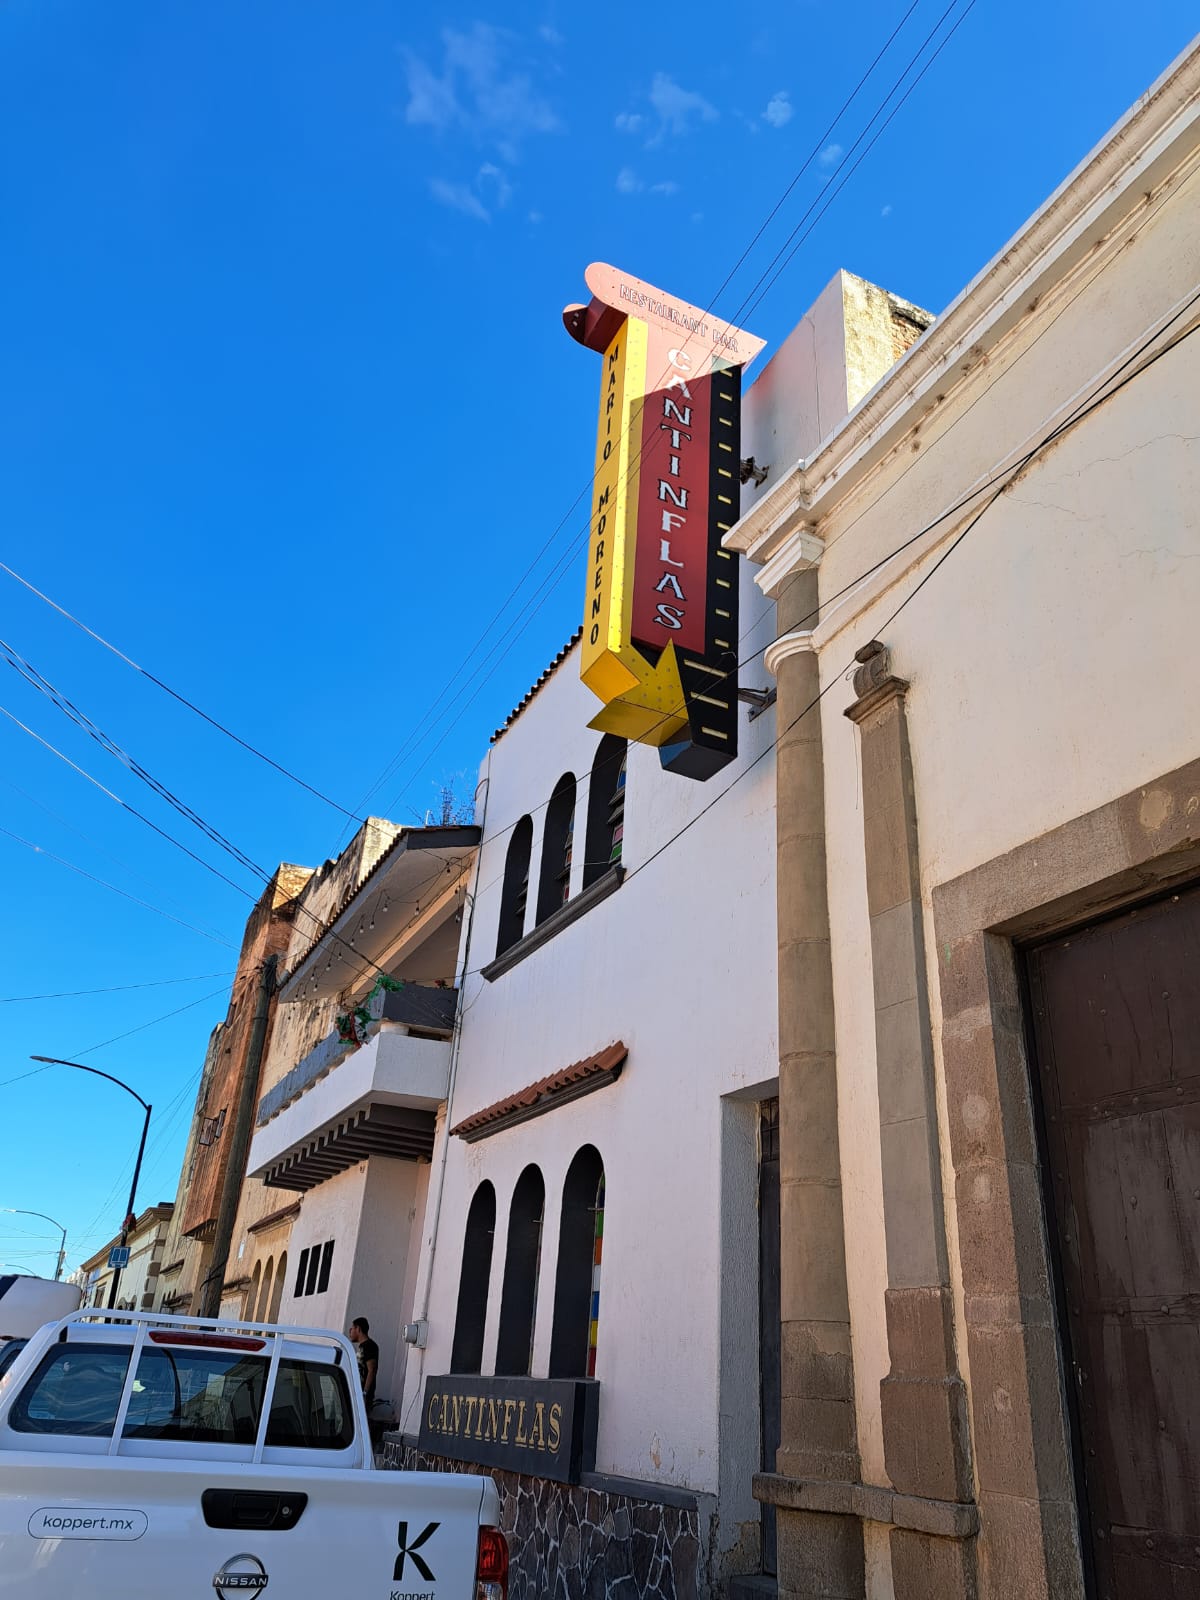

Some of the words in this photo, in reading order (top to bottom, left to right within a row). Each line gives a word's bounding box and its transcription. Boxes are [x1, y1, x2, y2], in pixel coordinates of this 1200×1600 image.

[620, 284, 708, 338] RESTAURANT
[712, 328, 739, 352] BAR
[603, 343, 619, 460] MARIO
[652, 348, 694, 631] CANTINFLAS
[589, 485, 610, 646] MORENO
[428, 1394, 563, 1454] CANTINFLAS
[43, 1515, 134, 1531] koppert.mx
[214, 1576, 268, 1586] NISSAN
